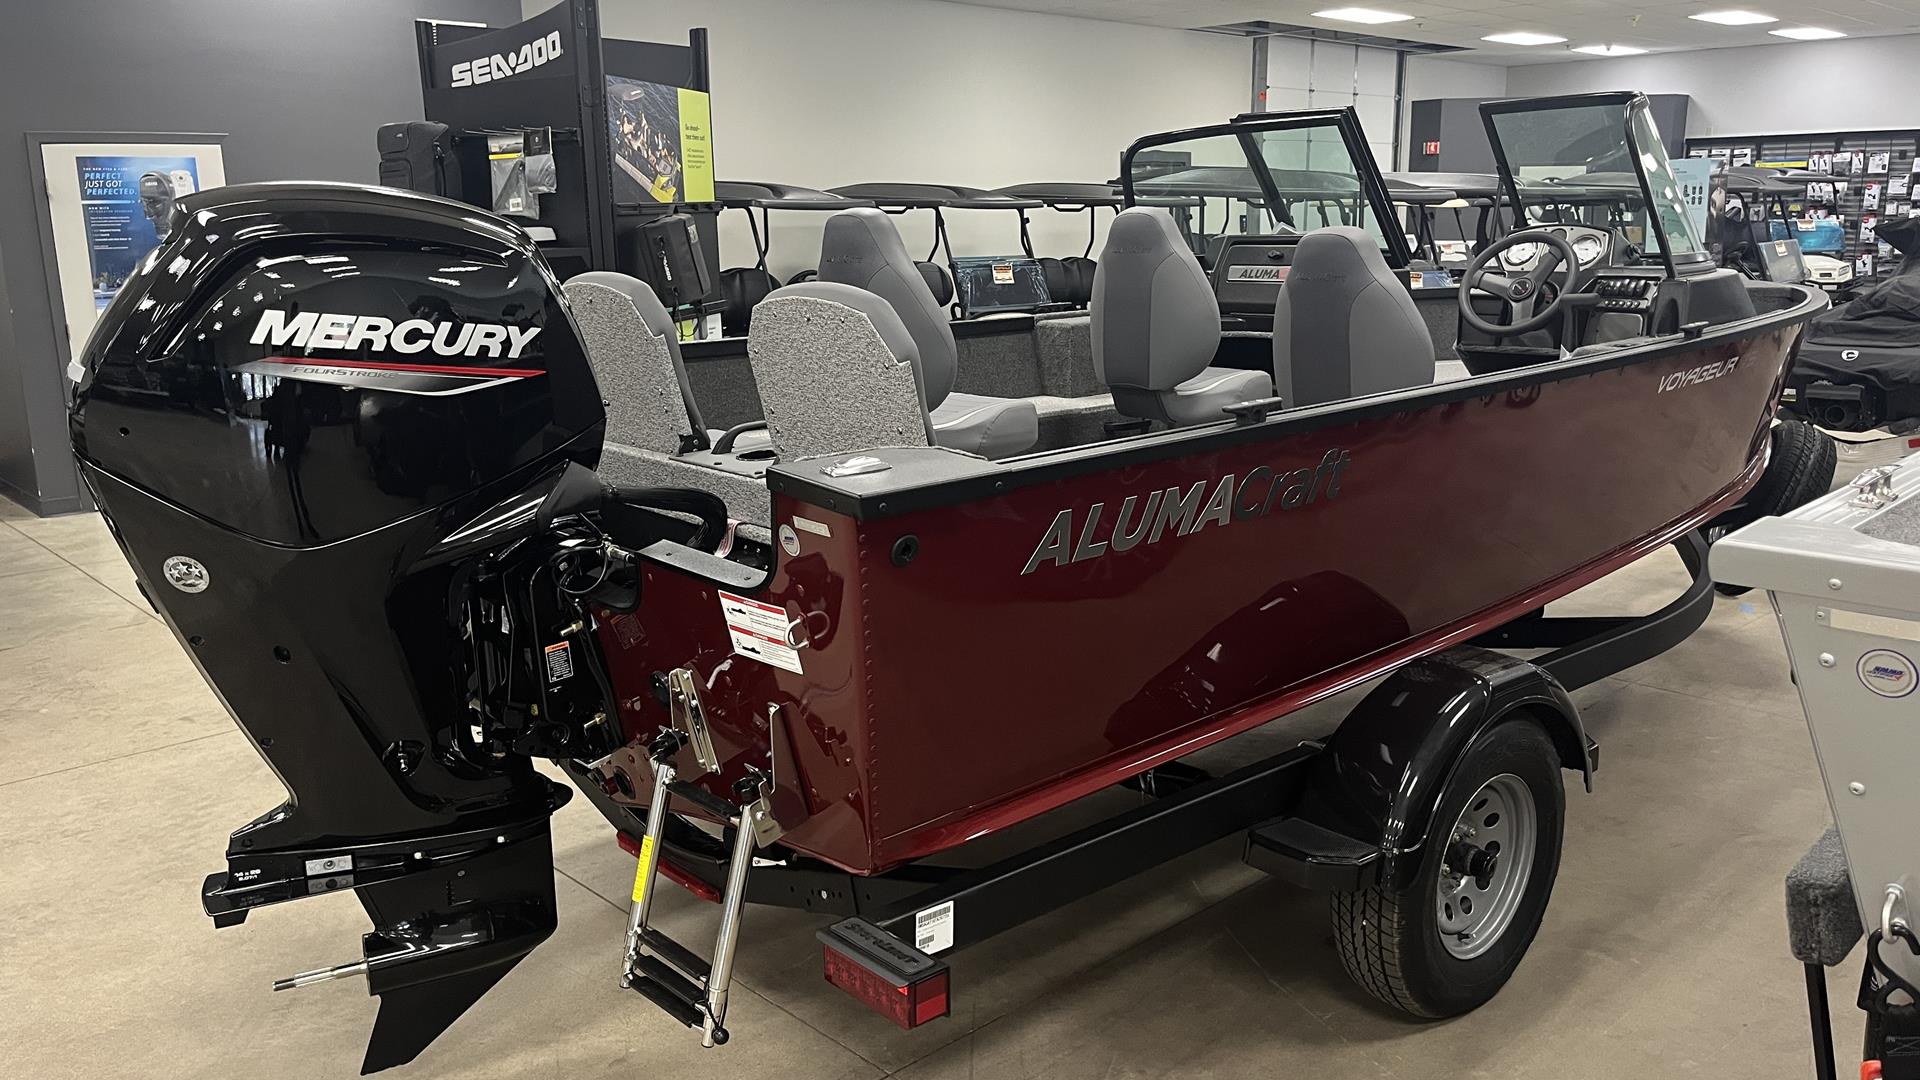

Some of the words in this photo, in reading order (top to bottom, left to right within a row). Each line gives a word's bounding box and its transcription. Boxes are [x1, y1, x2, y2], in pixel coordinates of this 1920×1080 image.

[84, 180, 104, 189] JUST
[105, 180, 122, 188] GOT
[250, 309, 541, 358] MERCURY
[1657, 356, 1740, 394] VOYAGEUR
